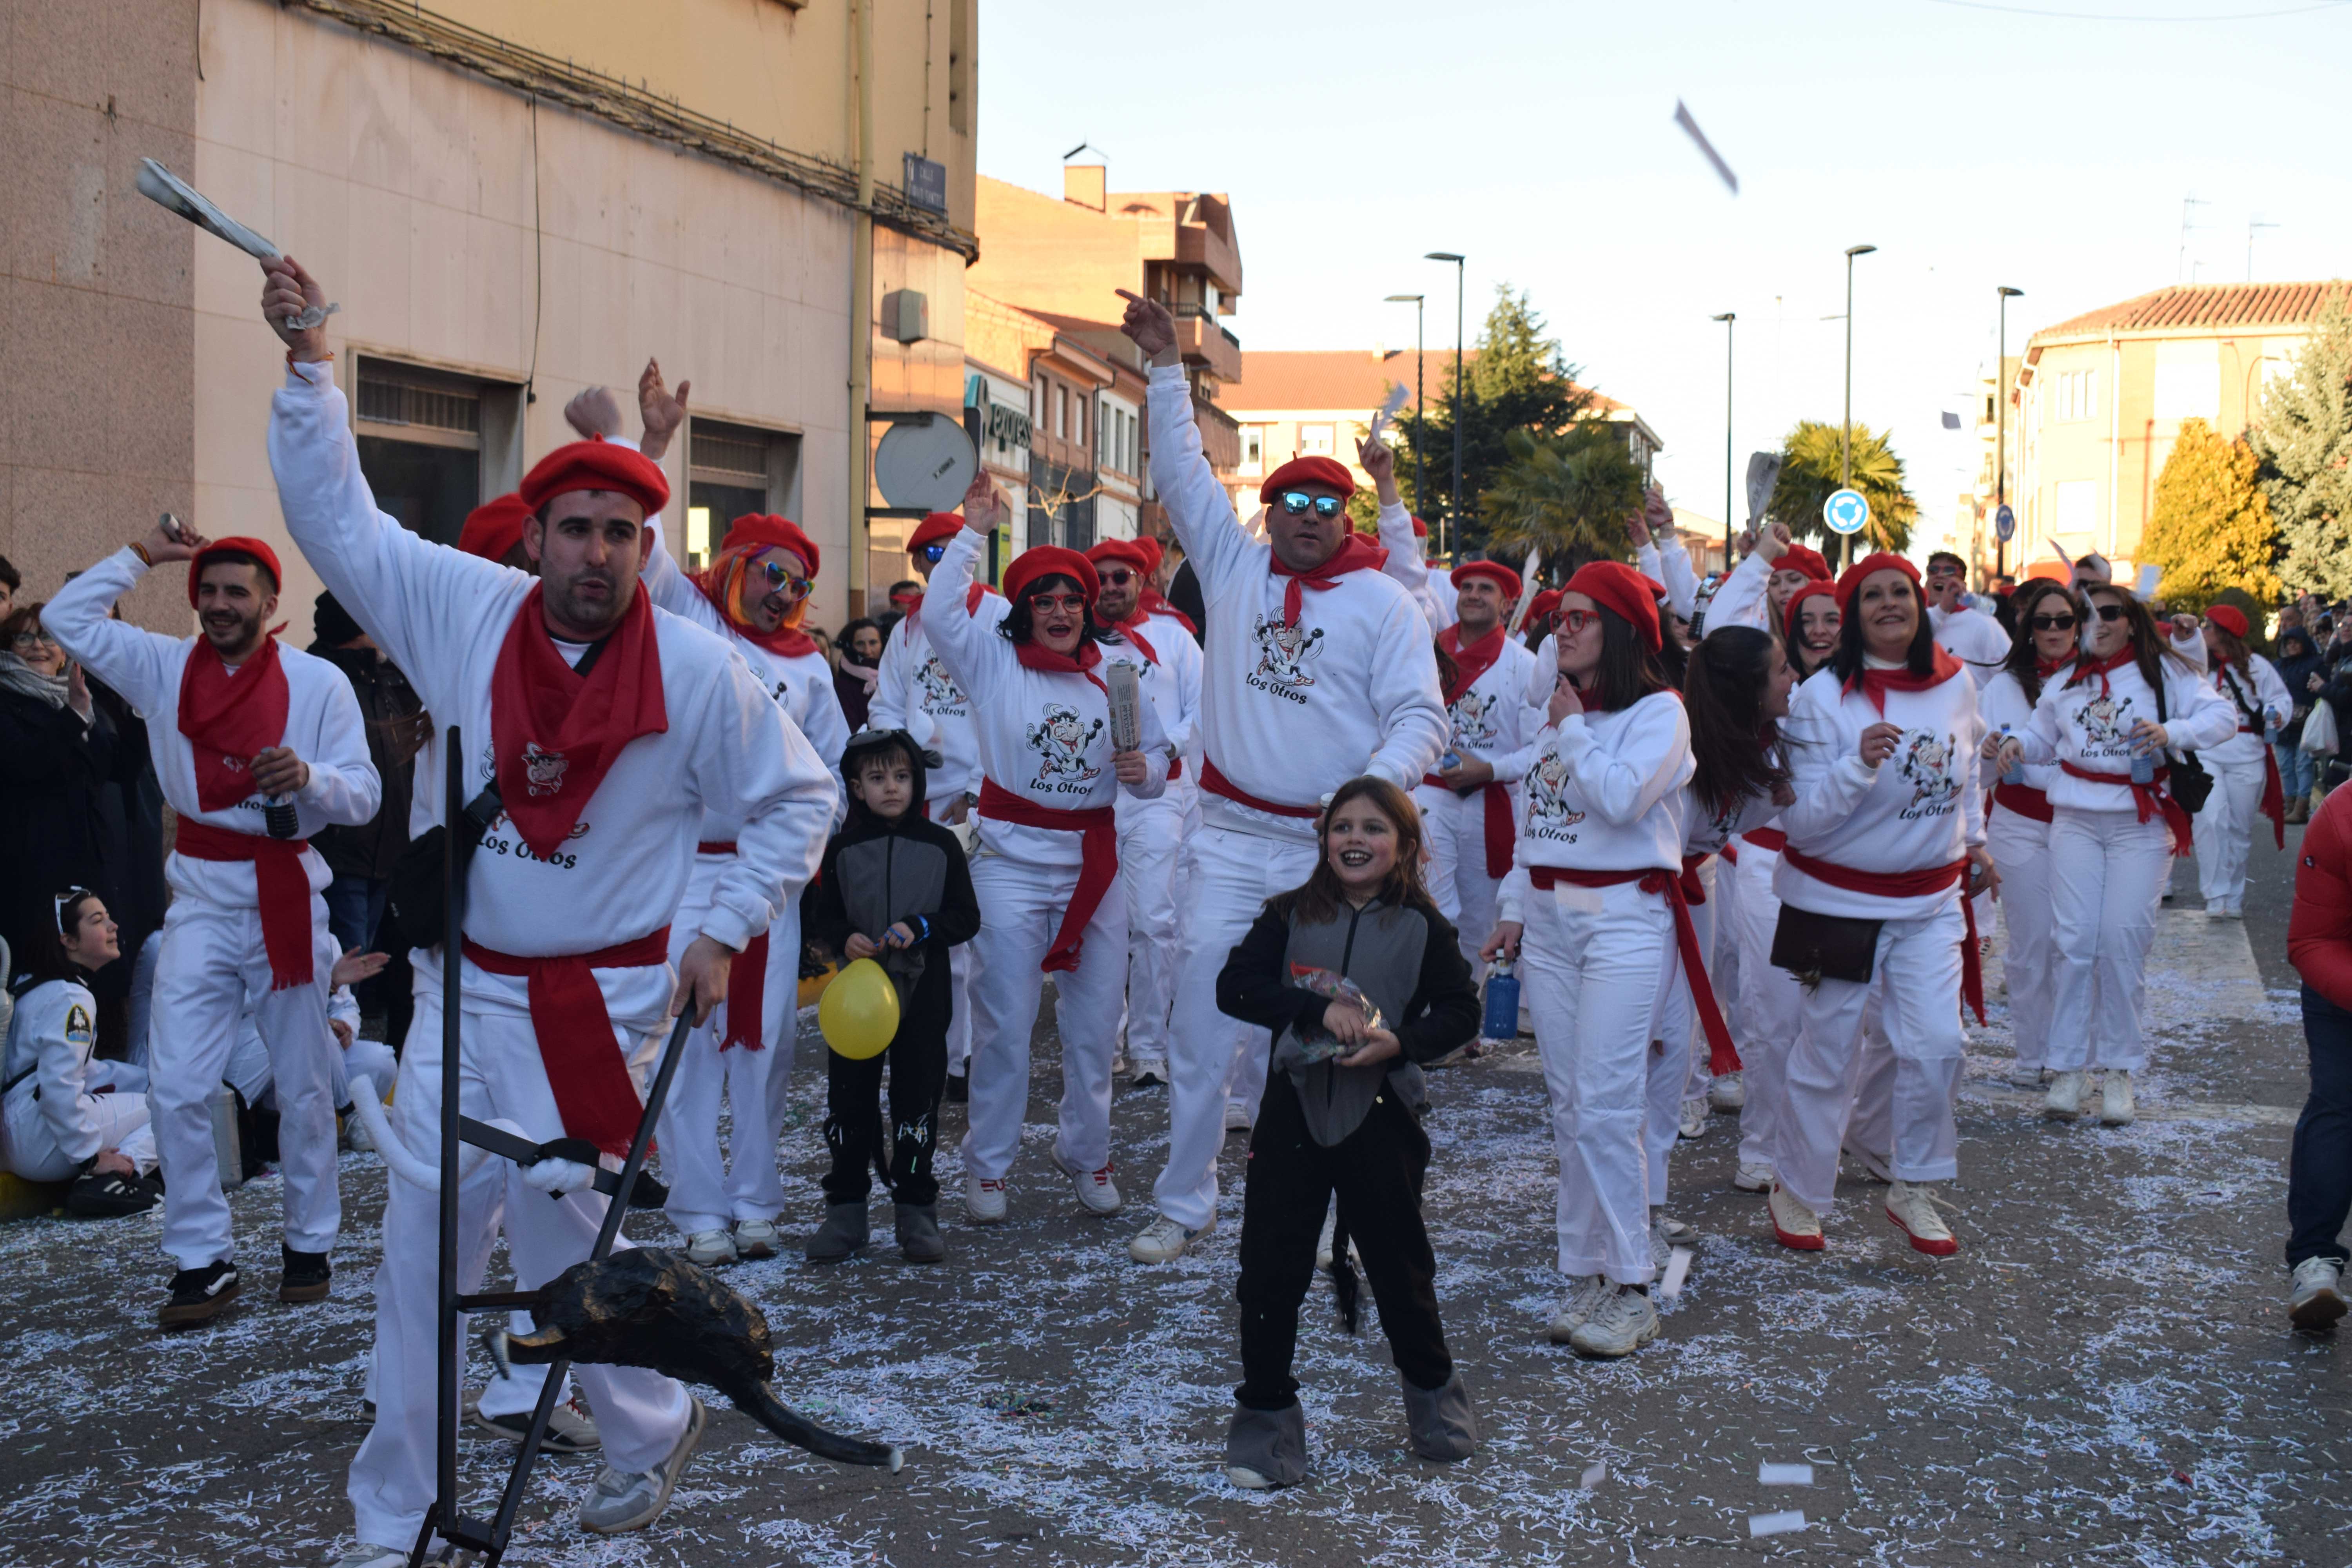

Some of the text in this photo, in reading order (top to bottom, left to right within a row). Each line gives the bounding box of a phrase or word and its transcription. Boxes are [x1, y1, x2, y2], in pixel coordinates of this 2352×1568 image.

[1246, 672, 1307, 704] Los Otros
[919, 706, 965, 717] os Otros
[1468, 740, 1494, 749] Otros
[2081, 748, 2131, 757] Los Otros
[1030, 778, 1093, 795] Los Otros
[238, 800, 265, 812] tros
[1899, 808, 1922, 819] Los
[1524, 824, 1577, 844] Los Otros
[477, 836, 577, 869] os Oos
